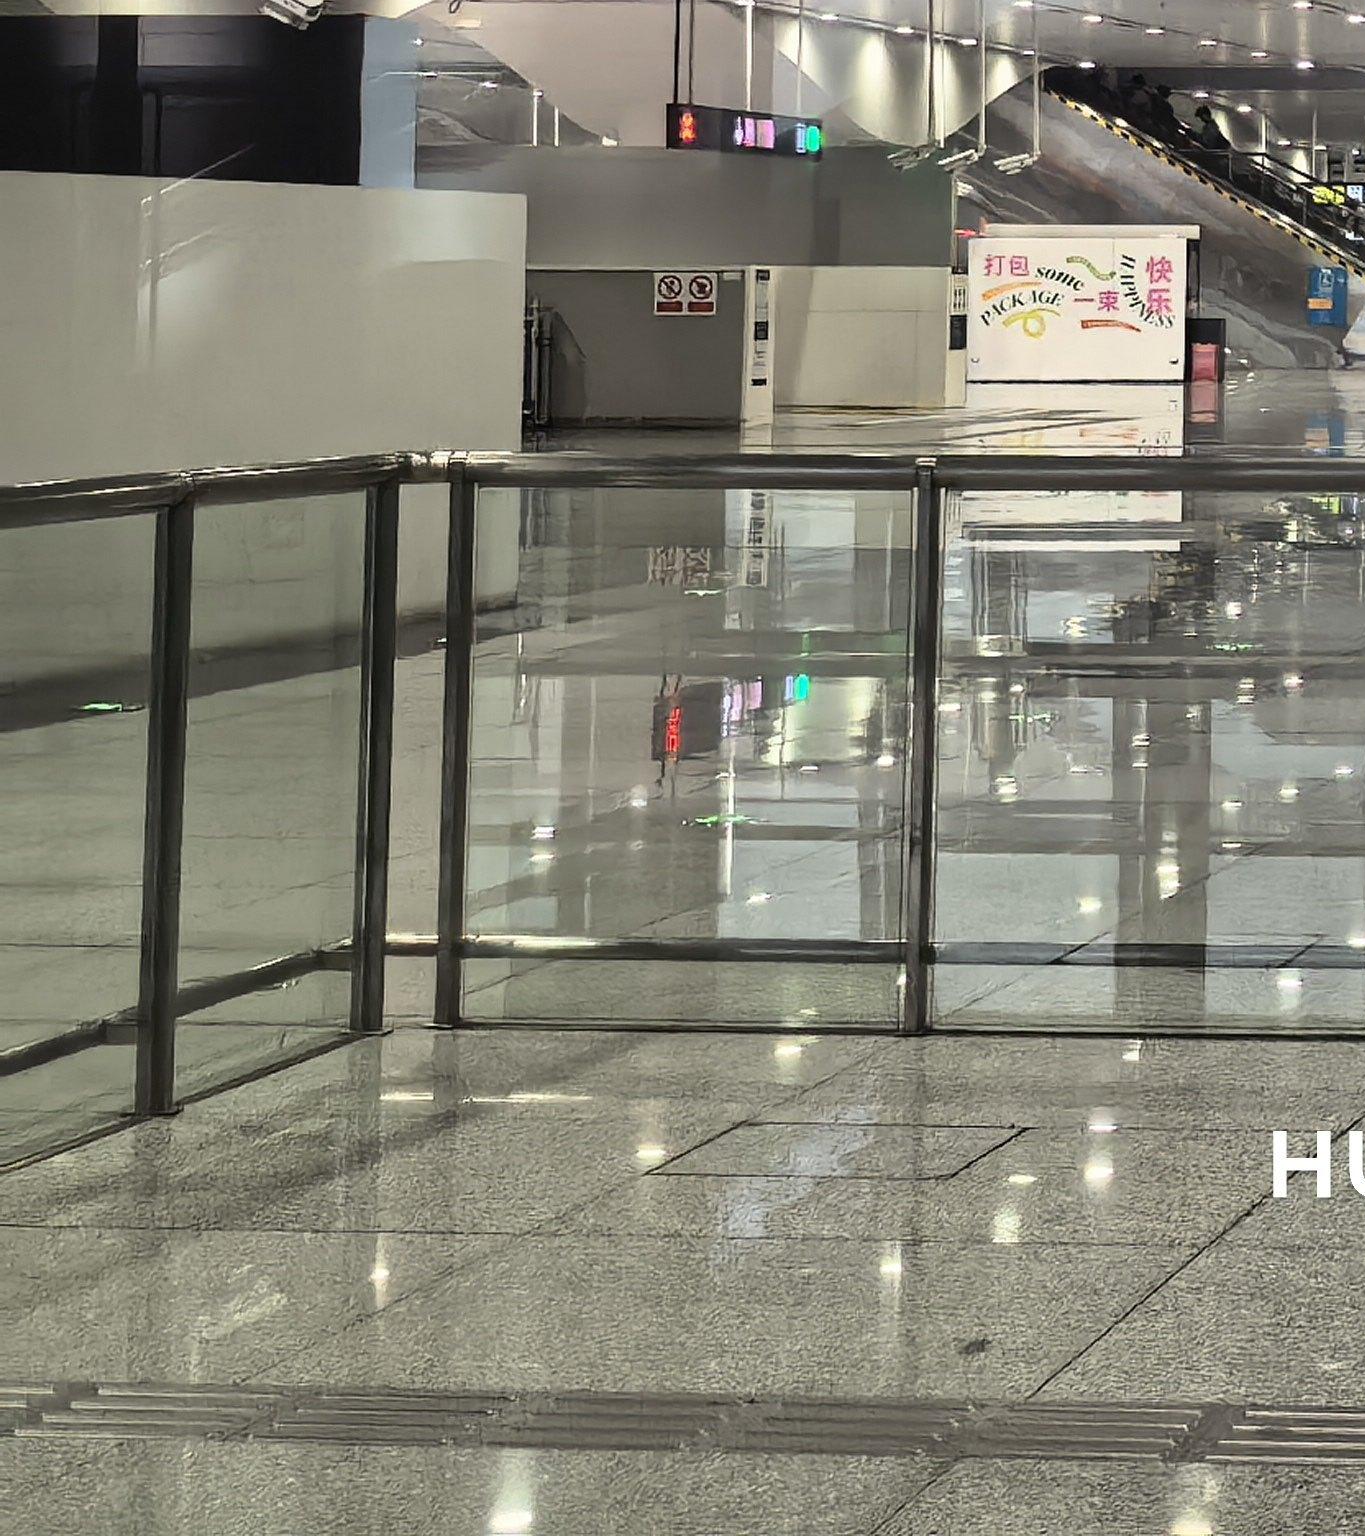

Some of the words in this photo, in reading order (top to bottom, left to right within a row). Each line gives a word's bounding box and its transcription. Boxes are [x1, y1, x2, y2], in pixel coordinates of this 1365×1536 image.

[984, 254, 1030, 277] 打包
[1145, 256, 1175, 316] 快乐
[980, 289, 1066, 327] PACKAGE
[1074, 291, 1120, 313] 一束
